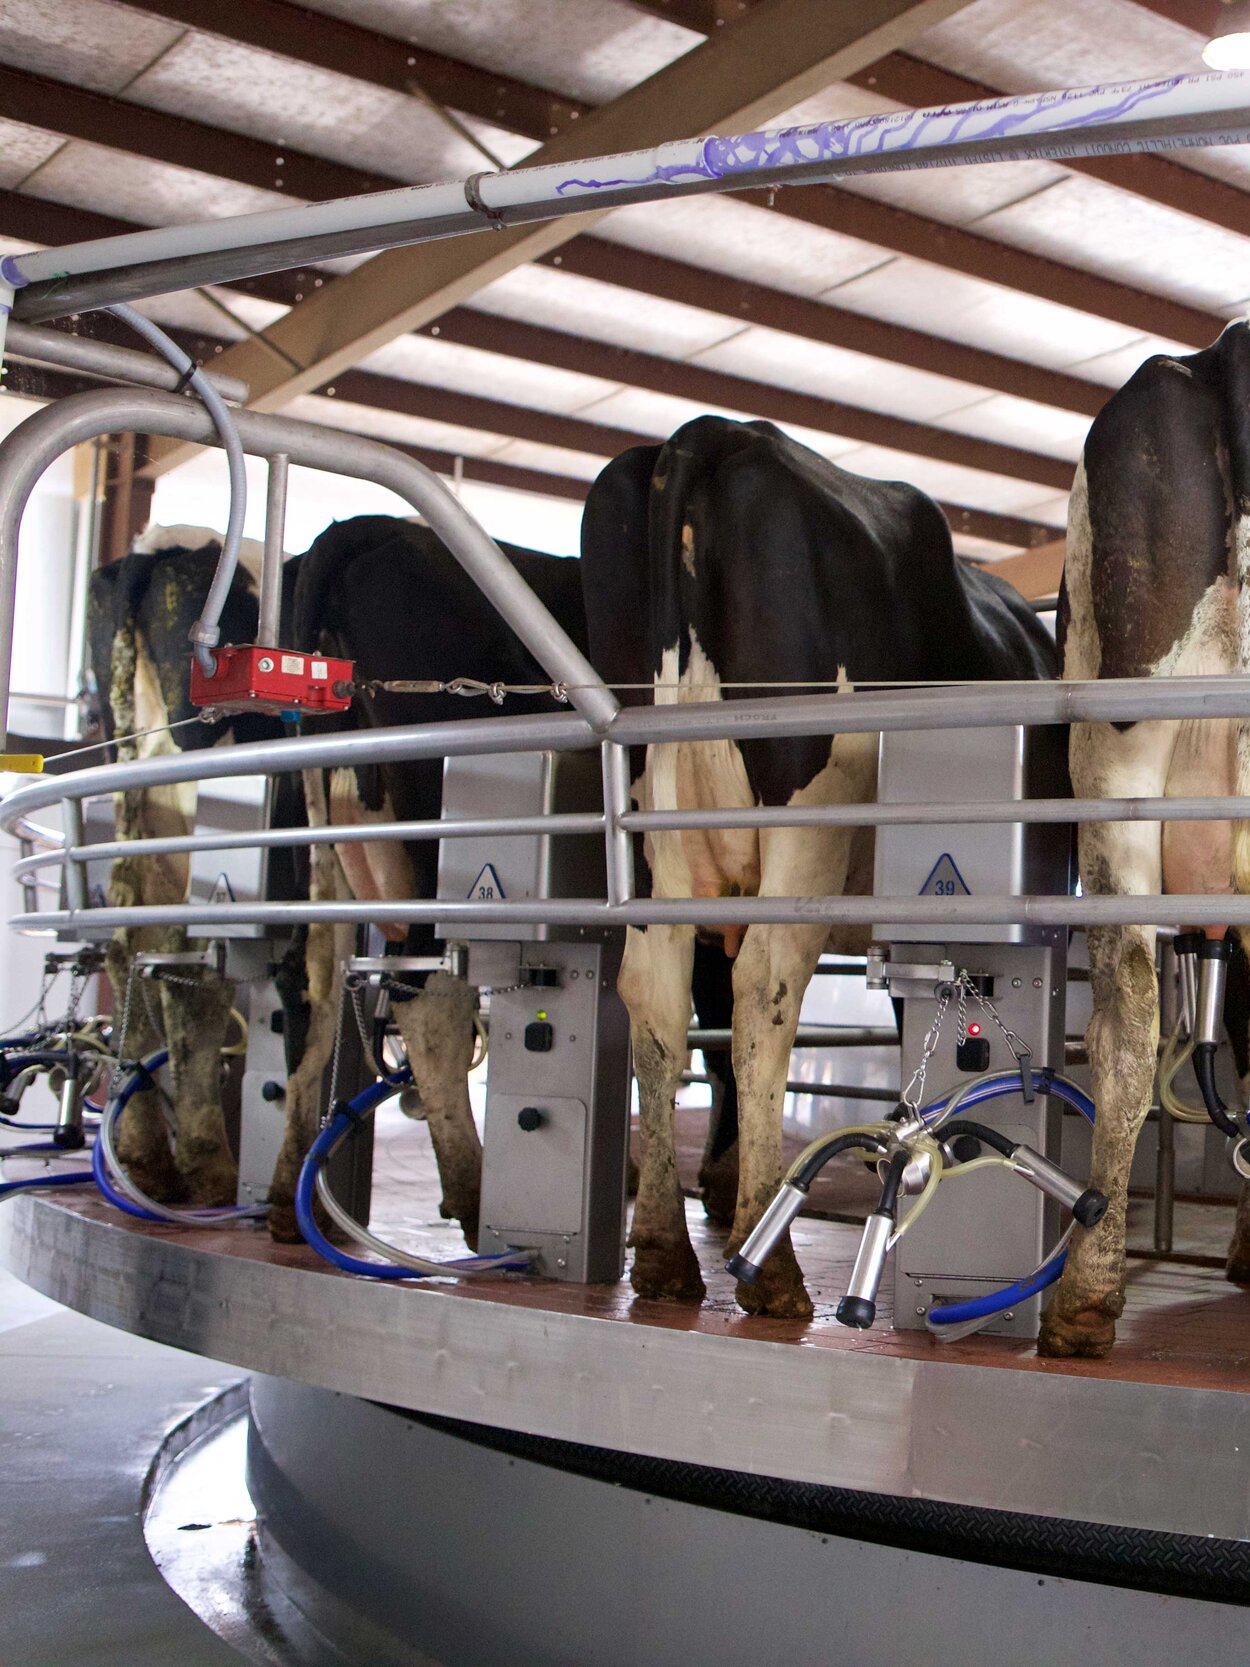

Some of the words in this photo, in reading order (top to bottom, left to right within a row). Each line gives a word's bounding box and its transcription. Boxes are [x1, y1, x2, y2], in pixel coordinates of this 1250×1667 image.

[1186, 76, 1199, 84] PR
[1205, 73, 1222, 82] PSI
[1136, 135, 1212, 151] NONMETALLIC
[1218, 134, 1240, 144] PVC
[1024, 146, 1076, 159] INTERTEK
[1084, 142, 1130, 155] CONDUIT
[964, 152, 1004, 164] LISTED
[478, 886, 494, 900] 38
[935, 880, 955, 896] 39
